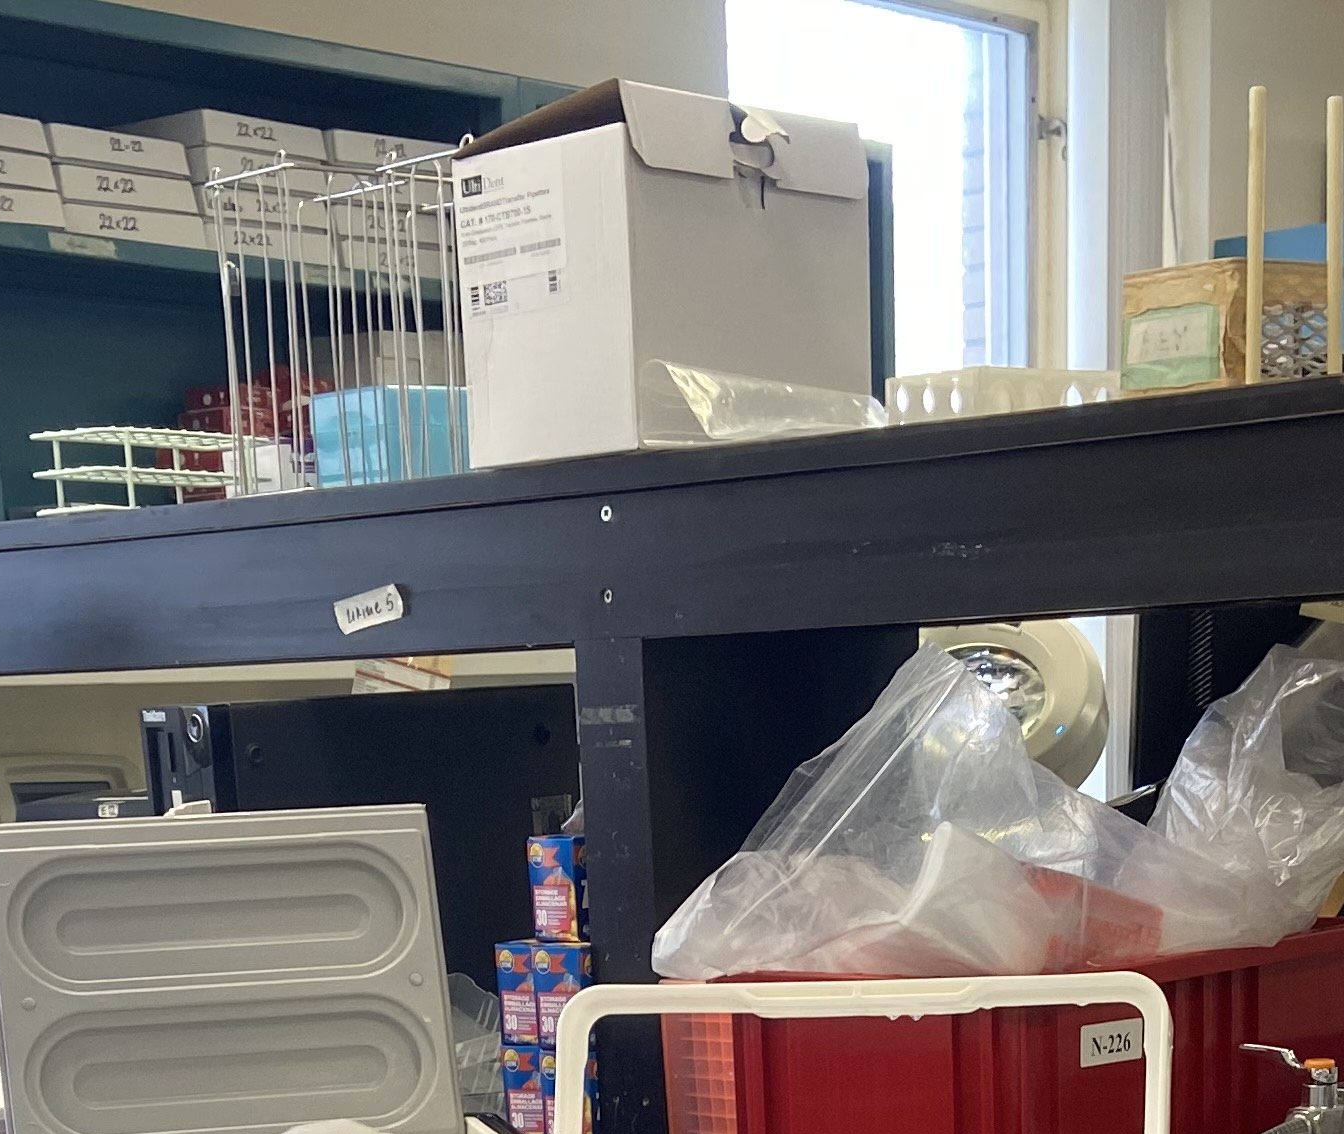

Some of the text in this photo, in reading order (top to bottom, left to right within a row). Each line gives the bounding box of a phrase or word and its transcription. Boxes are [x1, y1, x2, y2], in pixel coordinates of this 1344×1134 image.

[385, 592, 394, 611] 5
[535, 909, 548, 927] 30
[1090, 1033, 1132, 1057] N-226
[511, 1112, 525, 1129] 30
